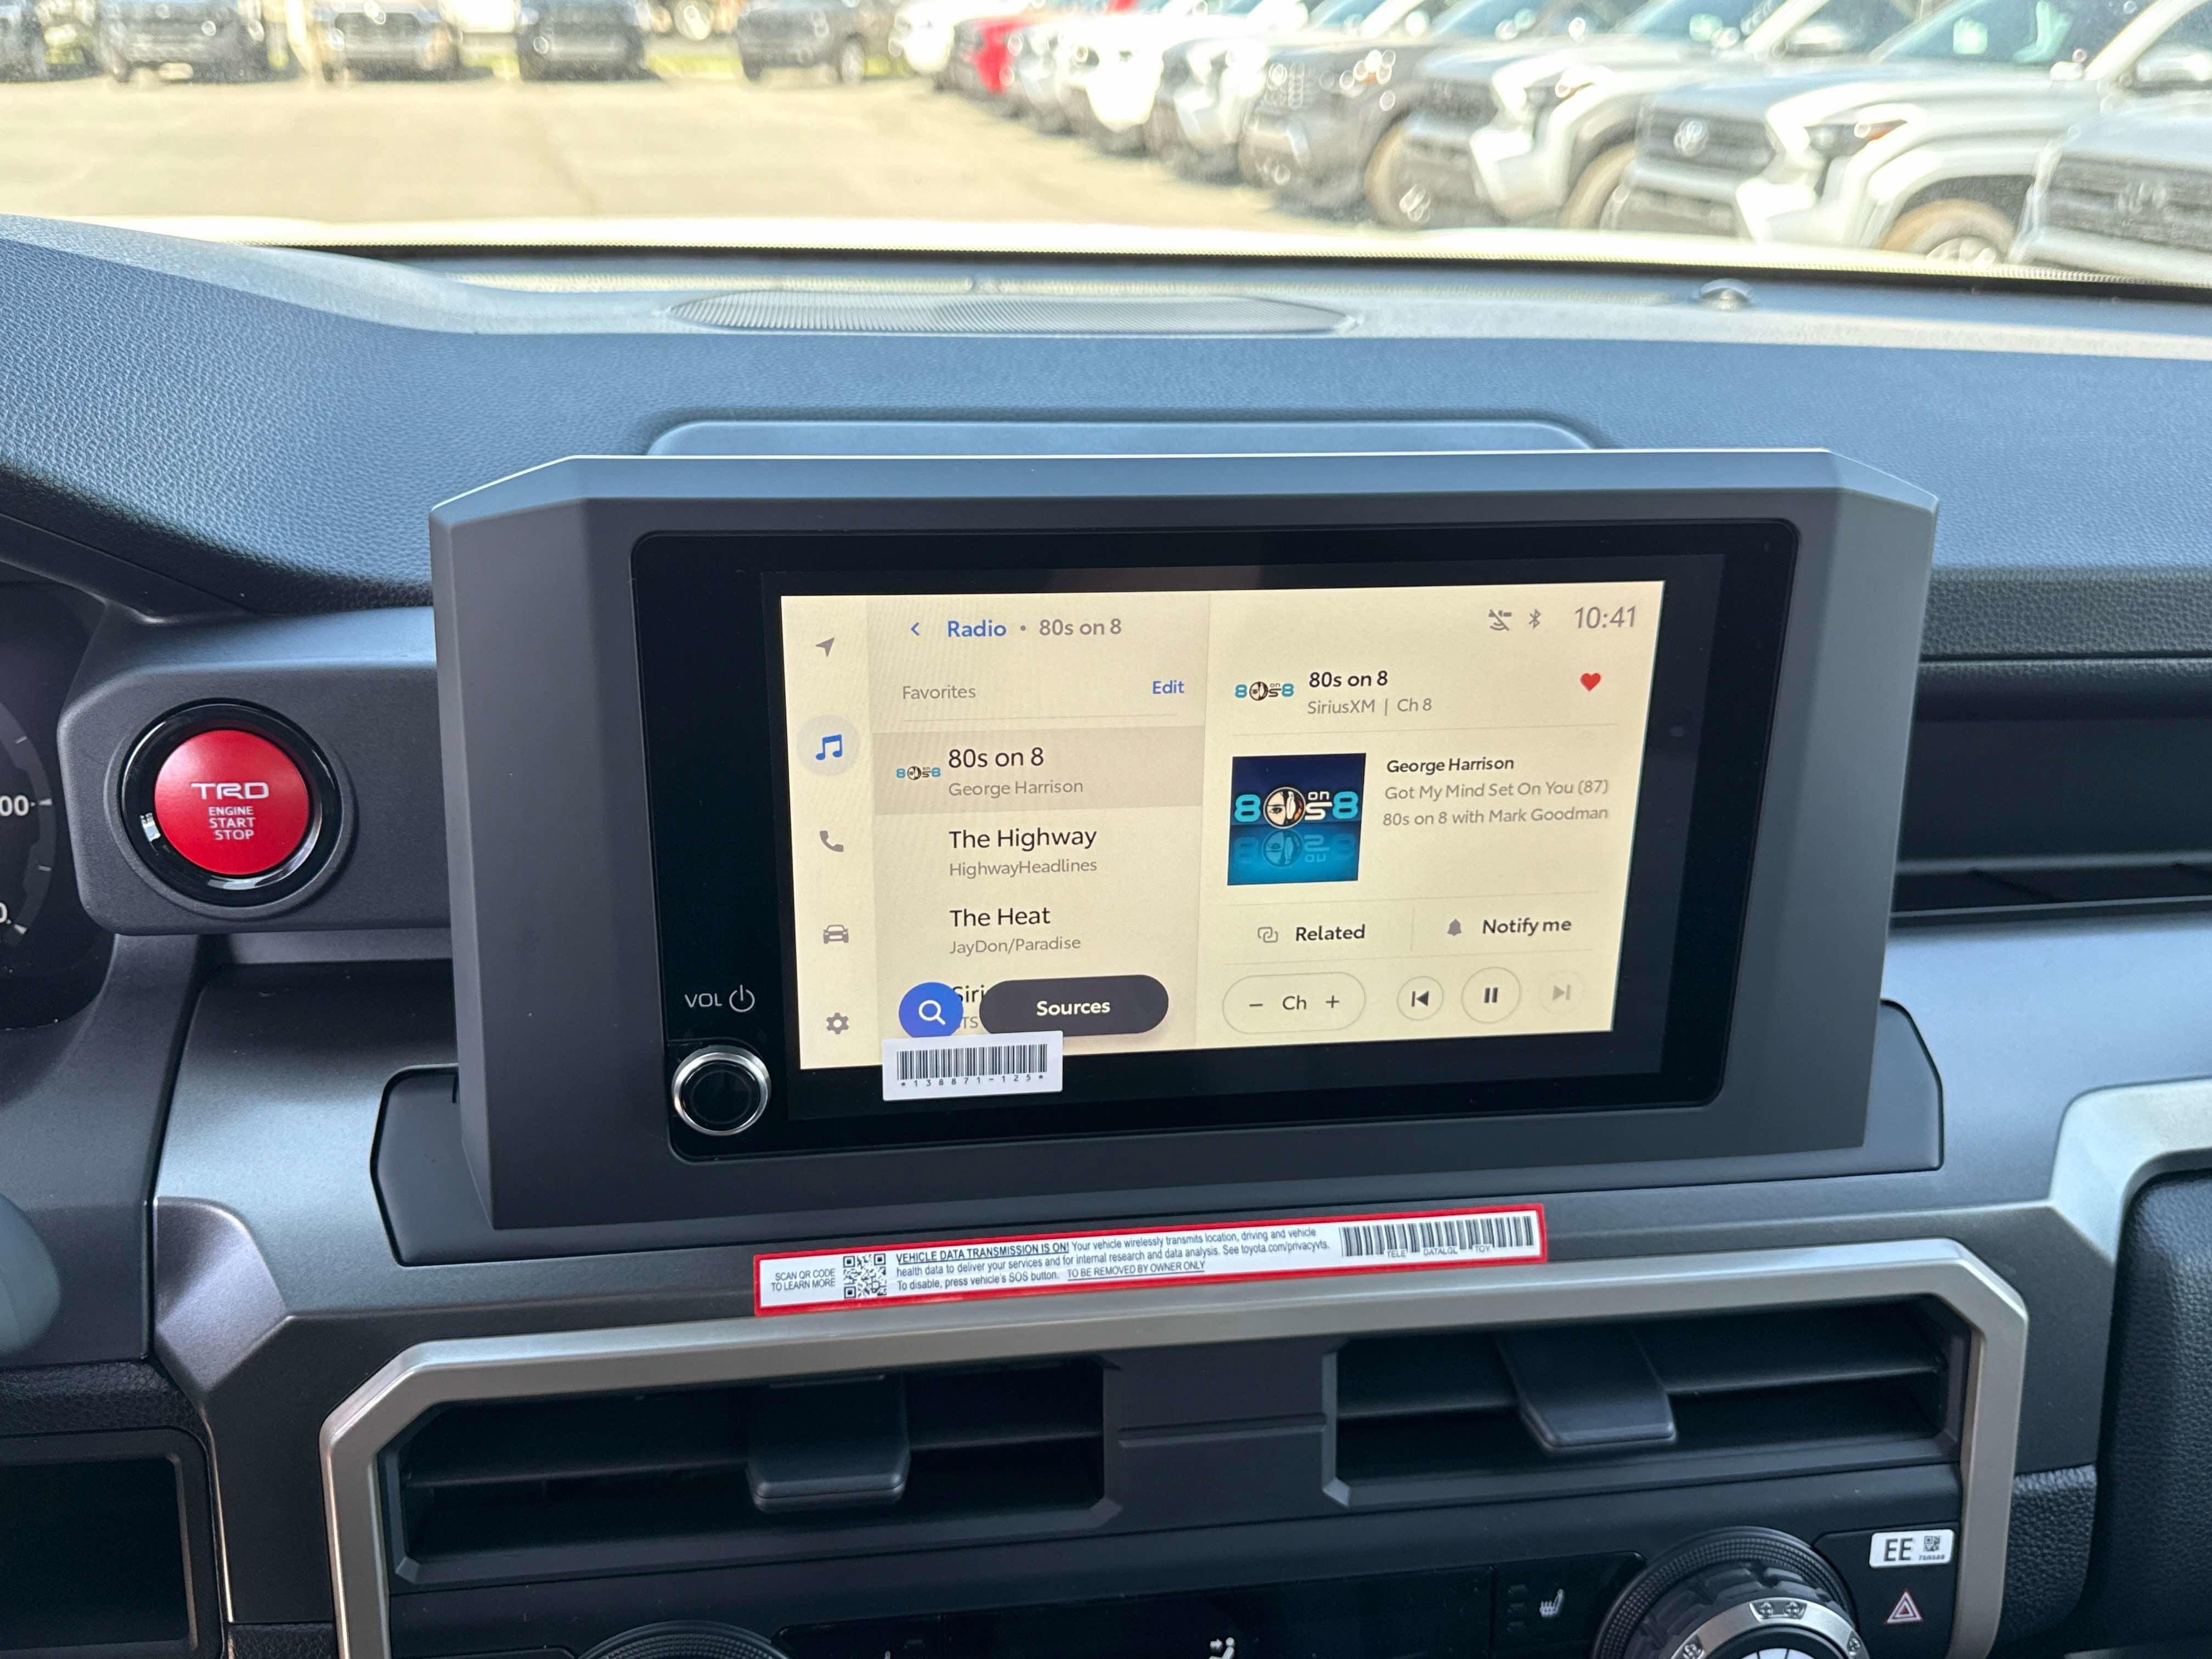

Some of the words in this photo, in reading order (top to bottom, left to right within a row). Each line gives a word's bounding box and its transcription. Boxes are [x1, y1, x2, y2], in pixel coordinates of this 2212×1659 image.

[1574, 606, 1637, 629] 10:41
[947, 620, 1007, 637] Radio
[1040, 619, 1074, 636] 80s
[1080, 622, 1105, 635] on
[1110, 618, 1121, 635] 8
[1153, 680, 1184, 695] Edit
[1309, 672, 1342, 687] 80s
[1347, 675, 1371, 687] on
[1376, 670, 1387, 686] 8
[902, 685, 976, 699] Favorites
[1307, 699, 1375, 714] SiriusXM
[1397, 698, 1418, 712] Ch
[1423, 698, 1432, 711] 8
[949, 748, 988, 768] 80s
[995, 752, 1024, 767] on
[1031, 747, 1044, 766] 8
[1386, 760, 1444, 775] George
[1449, 757, 1514, 771] Harrison
[191, 782, 269, 799] TRD
[949, 783, 1011, 798] George
[1015, 780, 1083, 794] Harrison
[1385, 786, 1414, 799] Got
[1420, 786, 1441, 802] My
[1446, 783, 1484, 798] Mind
[1489, 783, 1514, 797] Set
[1517, 782, 1541, 795] On
[1545, 781, 1573, 794] You
[1578, 779, 1609, 795] (87)
[208, 806, 253, 816] ENGINE
[1383, 813, 1409, 826] 80s
[1414, 816, 1434, 825] on
[1438, 812, 1447, 825] 8
[1453, 809, 1484, 823] with
[1489, 809, 1527, 822] Mark
[1531, 806, 1608, 821] Goodman
[209, 817, 255, 828] START
[215, 830, 254, 840] STOP
[949, 829, 990, 848] The
[998, 828, 1097, 851] Highway
[950, 859, 1097, 878] HighwayHeadlines
[950, 908, 991, 927] The
[997, 907, 1051, 926] Heat
[1295, 924, 1365, 941] Related
[1482, 918, 1539, 936] Notify
[1543, 920, 1572, 933] me
[950, 936, 1081, 956] JayDon/Paradise
[685, 993, 723, 1008] VOL
[1036, 1000, 1110, 1017] Sources
[1283, 996, 1307, 1011] Ch
[896, 1251, 937, 1263] VEHICLE
[940, 1249, 964, 1260] DATA
[967, 1244, 1039, 1257] TRANSMISSION
[1041, 1243, 1049, 1253] IS
[1052, 1242, 1069, 1252] ON!
[1071, 1242, 1091, 1251] Your
[1093, 1239, 1121, 1250] vehicle
[1124, 1236, 1163, 1248] wirelessly
[1166, 1234, 1203, 1245] transmits
[1205, 1232, 1239, 1243] location,
[1241, 1229, 1268, 1242] driving
[1271, 1229, 1285, 1239] and
[1288, 1226, 1316, 1238] vehicle
[1387, 1249, 1406, 1258] TELE
[1475, 1244, 1491, 1253] TOY
[896, 1265, 922, 1277] health
[925, 1264, 943, 1275] data
[946, 1264, 955, 1274] to
[957, 1261, 985, 1273] deliver
[988, 1262, 1006, 1273] your
[1008, 1257, 1042, 1269] services
[1045, 1255, 1060, 1266] and
[1063, 1255, 1074, 1265] for
[1076, 1252, 1106, 1264] internal
[1109, 1250, 1144, 1262] research
[1147, 1248, 1162, 1260] and
[1165, 1248, 1183, 1259] data
[1185, 1245, 1220, 1259] analysis.
[1223, 1244, 1239, 1255] See
[775, 1272, 797, 1281] SCAN
[799, 1270, 811, 1279] QR
[812, 1268, 836, 1278] CODE
[897, 1280, 907, 1290] To
[910, 1278, 943, 1290] disable,
[945, 1277, 968, 1289] press
[1009, 1271, 1028, 1283] SOS
[1031, 1270, 1059, 1281] button.
[1067, 1268, 1079, 1278] TO
[1081, 1267, 1092, 1277] BE
[1094, 1265, 1136, 1276] REMOVED
[1137, 1264, 1148, 1273] BY
[1150, 1262, 1182, 1272] OWNER
[1183, 1261, 1205, 1270] ONLY
[771, 1282, 782, 1291] TO
[784, 1280, 810, 1291] LEARN
[812, 1278, 836, 1288] MORE
[1884, 1537, 1913, 1561] EE
